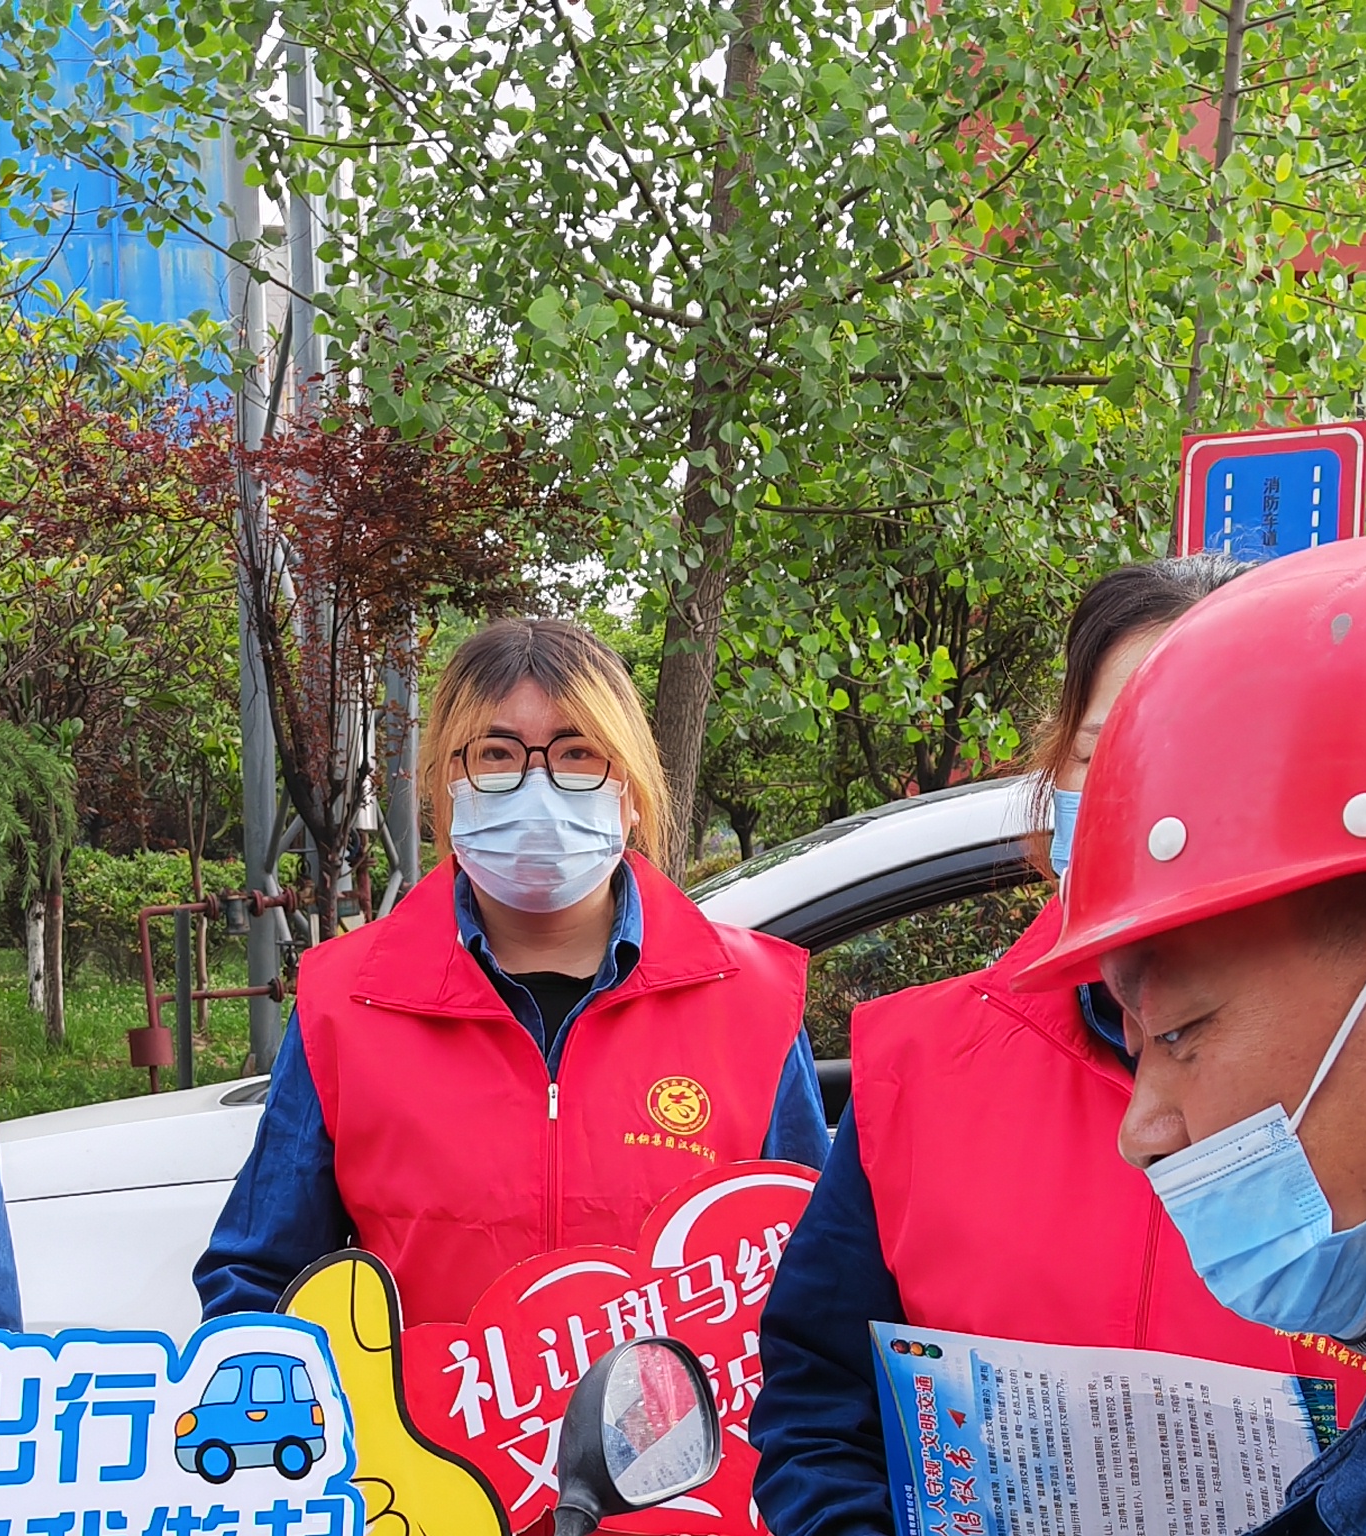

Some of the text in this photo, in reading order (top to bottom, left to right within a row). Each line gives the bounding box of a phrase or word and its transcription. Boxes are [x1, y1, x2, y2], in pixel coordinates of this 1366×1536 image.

[1261, 477, 1281, 546] 消防车道
[442, 1221, 794, 1440] 礼让斑马线
[909, 1373, 949, 1515] 人守规”文明交通
[943, 1441, 985, 1536] 倡议书
